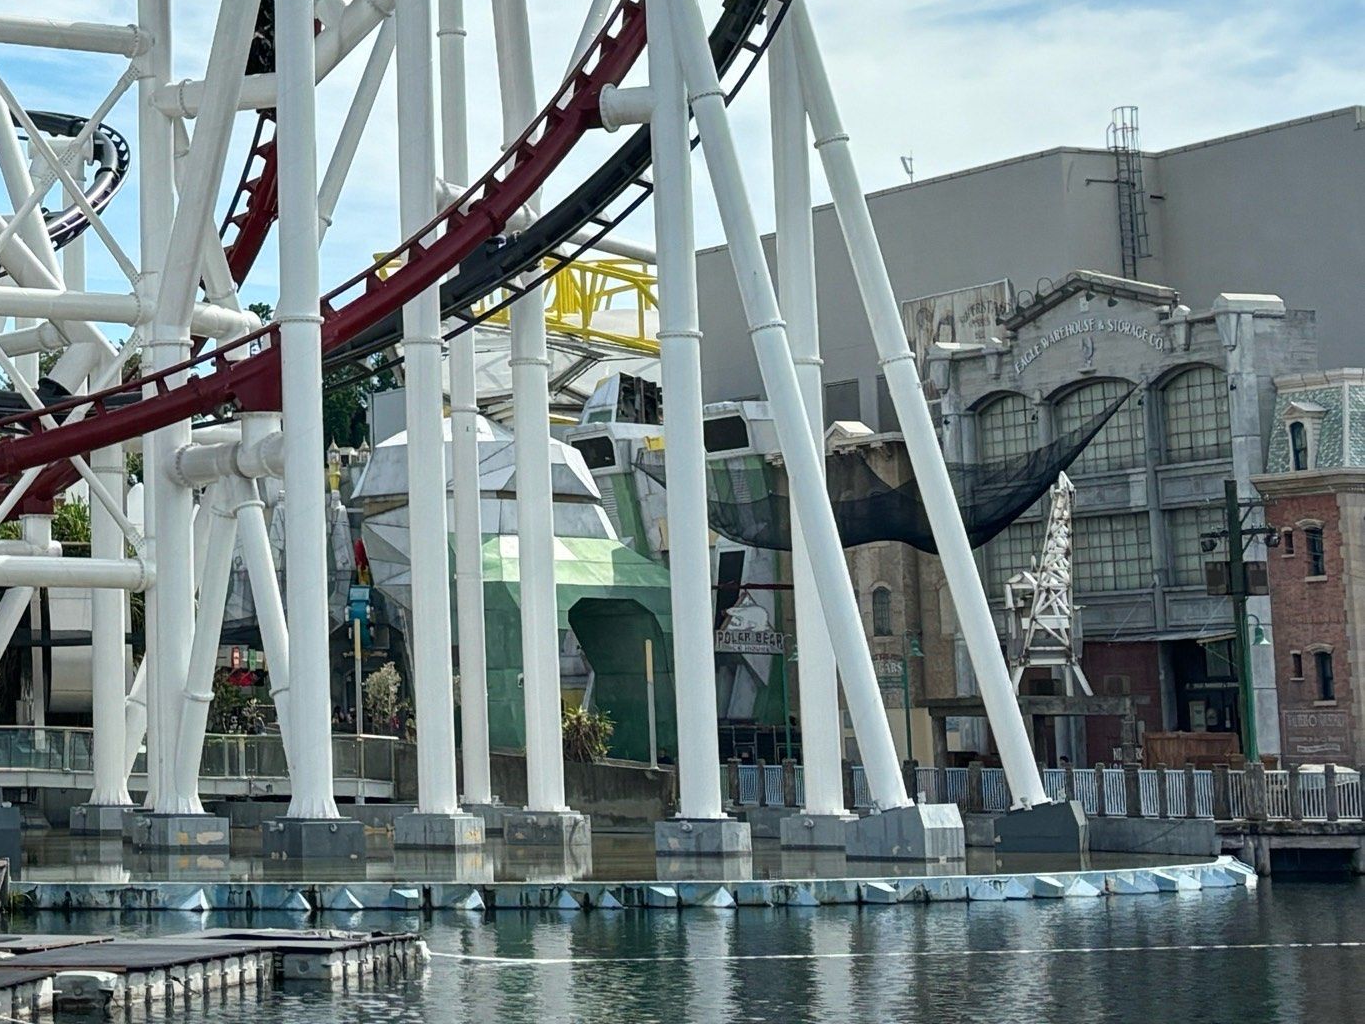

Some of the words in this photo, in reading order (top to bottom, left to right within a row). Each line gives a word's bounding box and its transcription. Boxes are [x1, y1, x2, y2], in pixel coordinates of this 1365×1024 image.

[1014, 345, 1042, 375] EAGLE
[1040, 318, 1095, 349] WAREHOUSE
[1098, 320, 1105, 330] &
[1108, 319, 1149, 342] STORAGE
[717, 631, 751, 647] POLAR
[755, 632, 784, 649] BEAR
